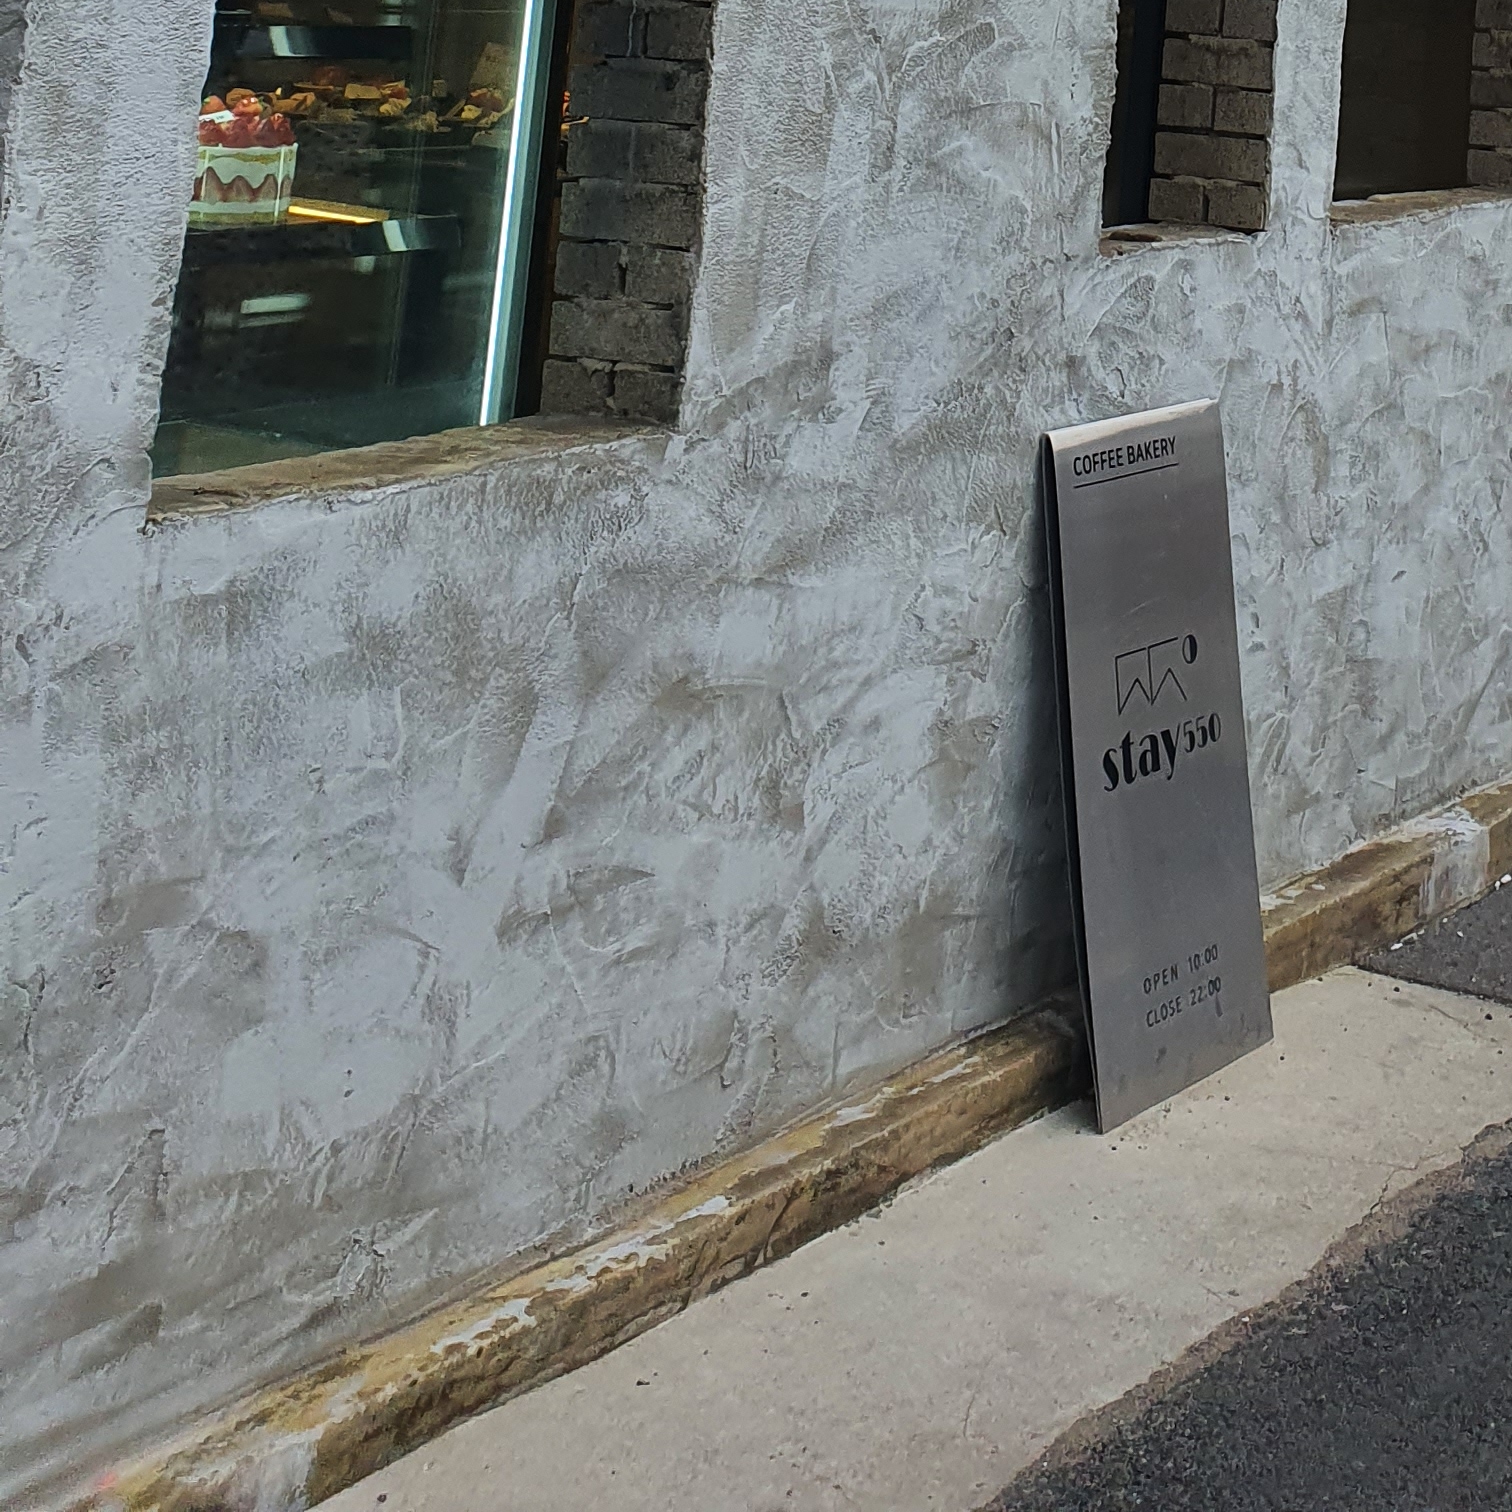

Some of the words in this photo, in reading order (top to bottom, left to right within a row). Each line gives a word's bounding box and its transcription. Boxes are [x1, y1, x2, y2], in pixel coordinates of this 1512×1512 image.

[1073, 447, 1124, 476] COFFEE
[1126, 435, 1176, 465] BAKERY
[1102, 712, 1222, 792] stay550
[1143, 964, 1179, 995] OPEN
[1188, 944, 1219, 974] 10:00
[1146, 995, 1183, 1028] CLOSE
[1189, 976, 1222, 1006] 22:00
